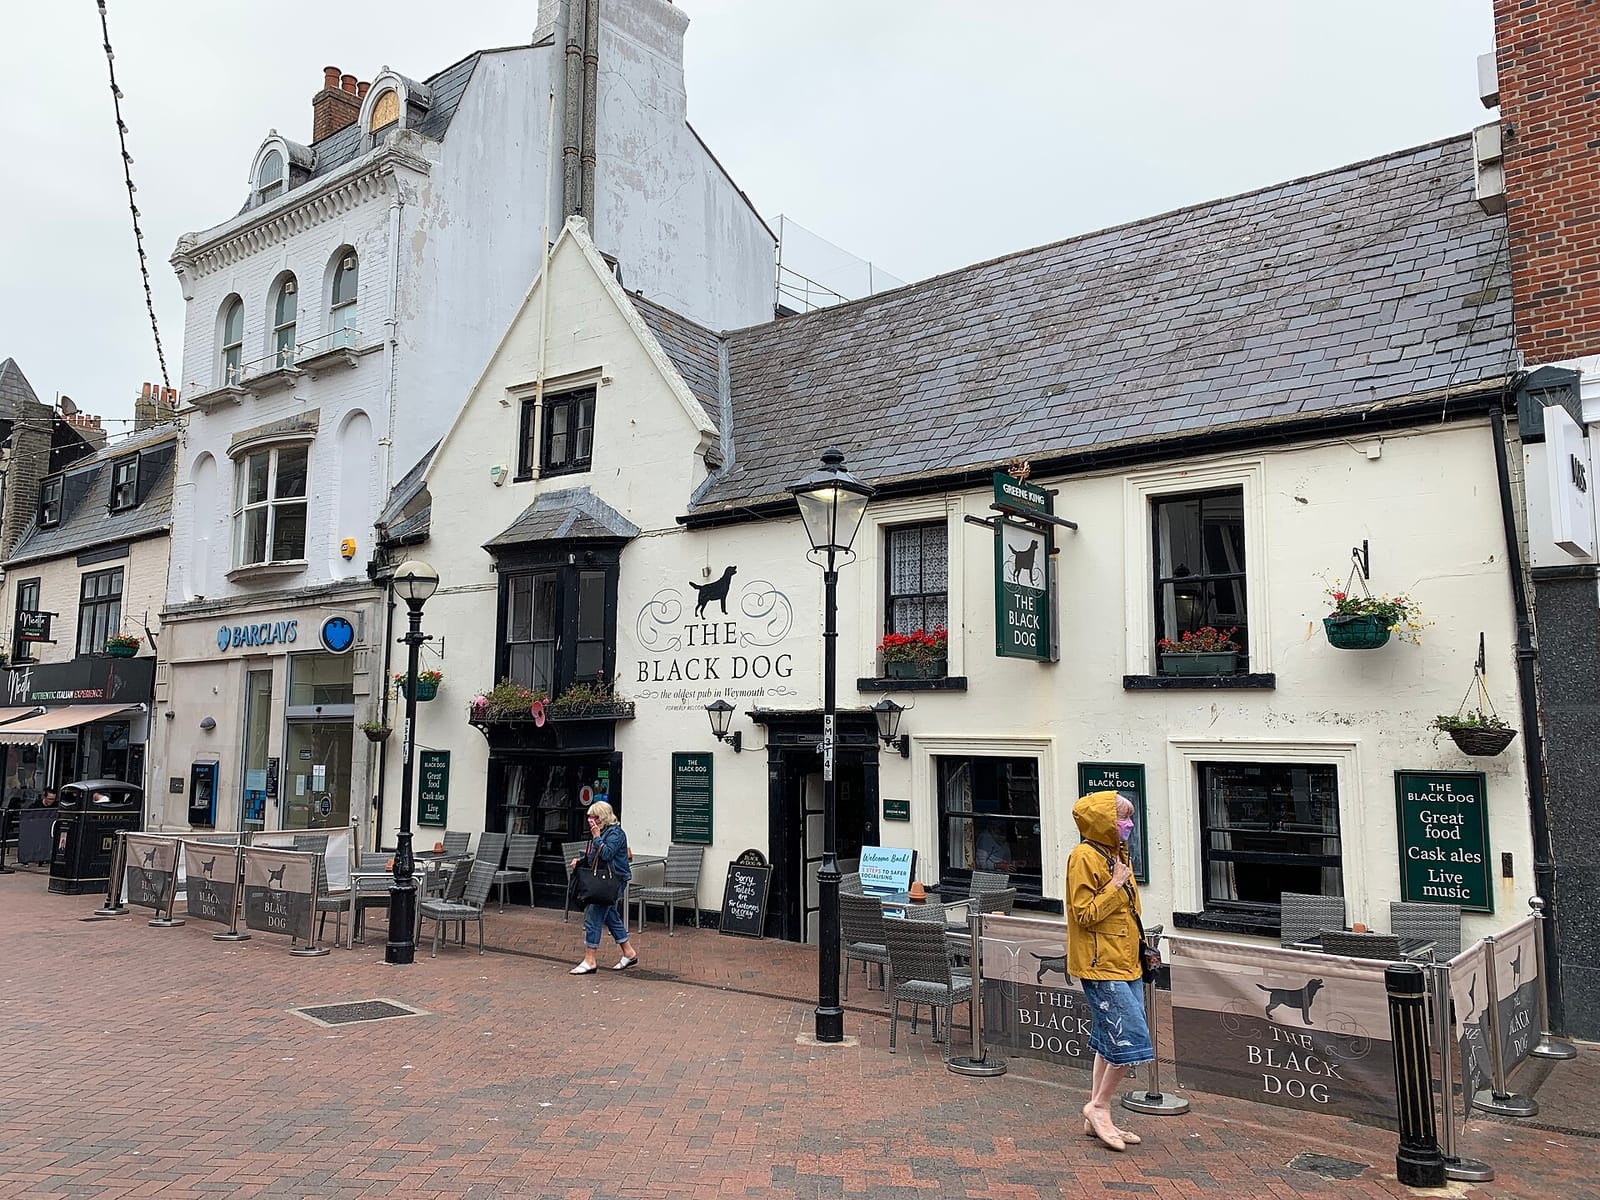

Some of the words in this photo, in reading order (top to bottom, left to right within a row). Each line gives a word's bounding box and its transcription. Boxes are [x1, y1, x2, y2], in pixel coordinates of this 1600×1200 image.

[1003, 483, 1028, 500] GREENE
[1028, 491, 1045, 505] KING
[1014, 593, 1034, 611] THE
[1008, 610, 1040, 630] BLACK
[231, 620, 298, 648] BARCLAYS
[684, 622, 738, 647] THE
[1014, 630, 1036, 647] DOG
[636, 657, 720, 682] BLACK
[731, 654, 793, 679] DOG
[660, 689, 672, 699] the
[673, 688, 696, 699] oldest
[696, 687, 712, 700] pub
[713, 688, 722, 697] in
[724, 686, 765, 699] Weymouth
[427, 771, 442, 780] Great
[1103, 771, 1120, 779] THE
[428, 780, 440, 788] food
[1116, 780, 1135, 788] DOG
[1428, 783, 1452, 792] THE
[422, 791, 434, 800] Cask
[1407, 792, 1445, 802] BLACK
[1447, 794, 1475, 803] DOG
[427, 803, 439, 812] Live
[1420, 810, 1464, 825] Great
[1425, 824, 1461, 840] food
[862, 853, 890, 862] Welcome
[890, 853, 909, 863] Back!
[1408, 846, 1446, 861] Cask
[1450, 848, 1481, 863] ales
[1428, 869, 1463, 884] Live
[1423, 885, 1471, 899] music
[202, 904, 216, 916] DOG
[268, 915, 286, 929] DOG
[1036, 991, 1074, 1009] THE
[1018, 1008, 1091, 1036] BLACK
[1029, 1031, 1081, 1057] DOG
[1269, 1025, 1314, 1051] THE
[1246, 1045, 1345, 1080] BLACK
[1262, 1073, 1331, 1104] DOG
